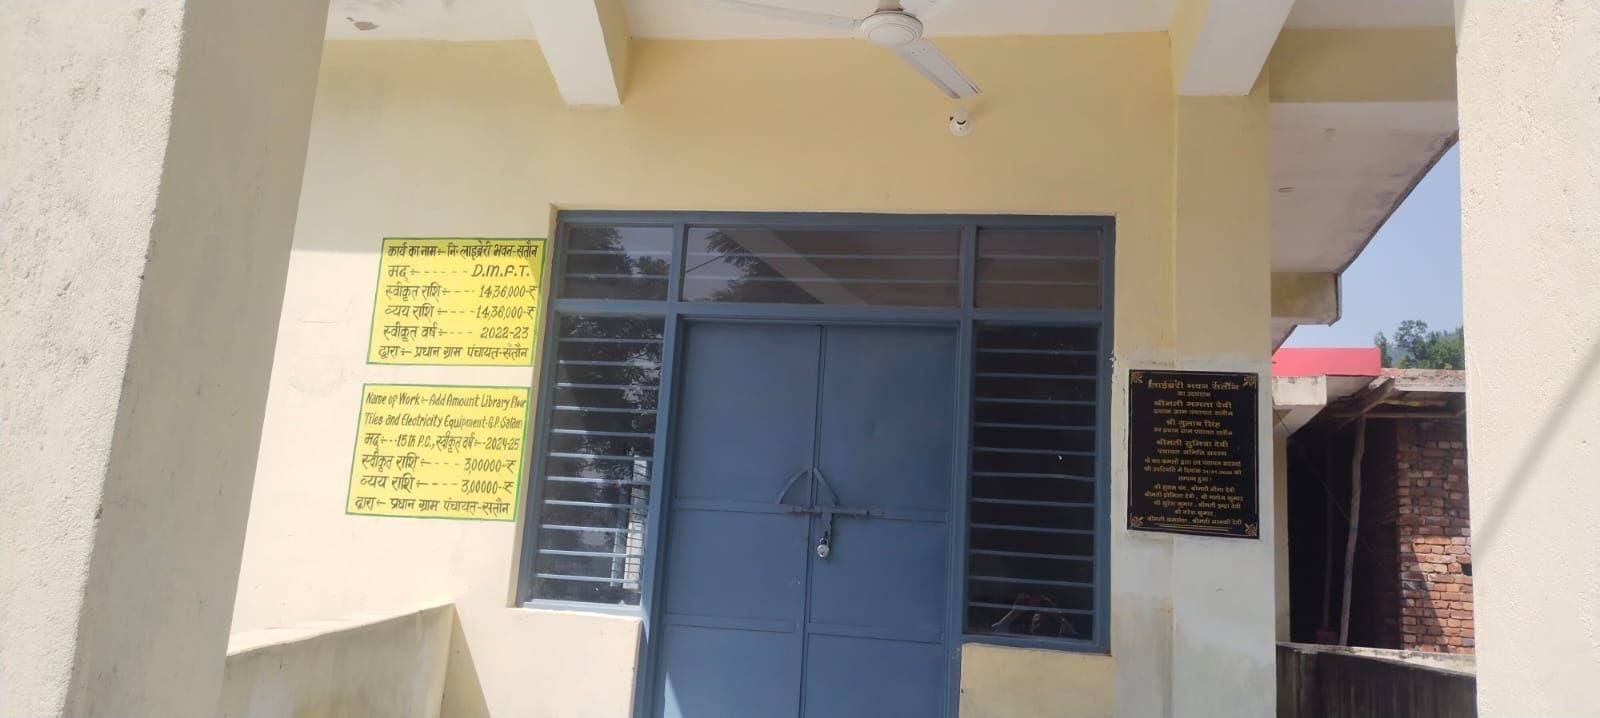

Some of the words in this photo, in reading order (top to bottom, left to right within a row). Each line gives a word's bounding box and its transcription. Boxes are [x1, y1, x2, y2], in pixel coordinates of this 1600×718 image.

[388, 241, 408, 257] कार्य
[408, 245, 420, 258] का
[385, 281, 421, 302] स्वीकृत
[384, 304, 411, 318] व्यय
[383, 321, 420, 342] स्वीकृत
[480, 326, 530, 339] 2022-23
[413, 346, 442, 358] प्रधान
[443, 346, 464, 359] ग्राम
[365, 391, 387, 405] Name
[388, 393, 398, 408] of
[429, 392, 446, 406] Add
[446, 393, 480, 407] Amount
[479, 393, 511, 411] Library
[364, 412, 384, 425] Tiles
[385, 412, 401, 426] and
[401, 412, 443, 428] Electricity
[435, 430, 463, 454] स्वीकृत
[485, 436, 521, 450] 2024-25
[361, 450, 395, 472] स्वीकृत
[360, 475, 389, 489] व्यय
[390, 497, 416, 511] प्रधान
[418, 498, 440, 512] ग्राम
